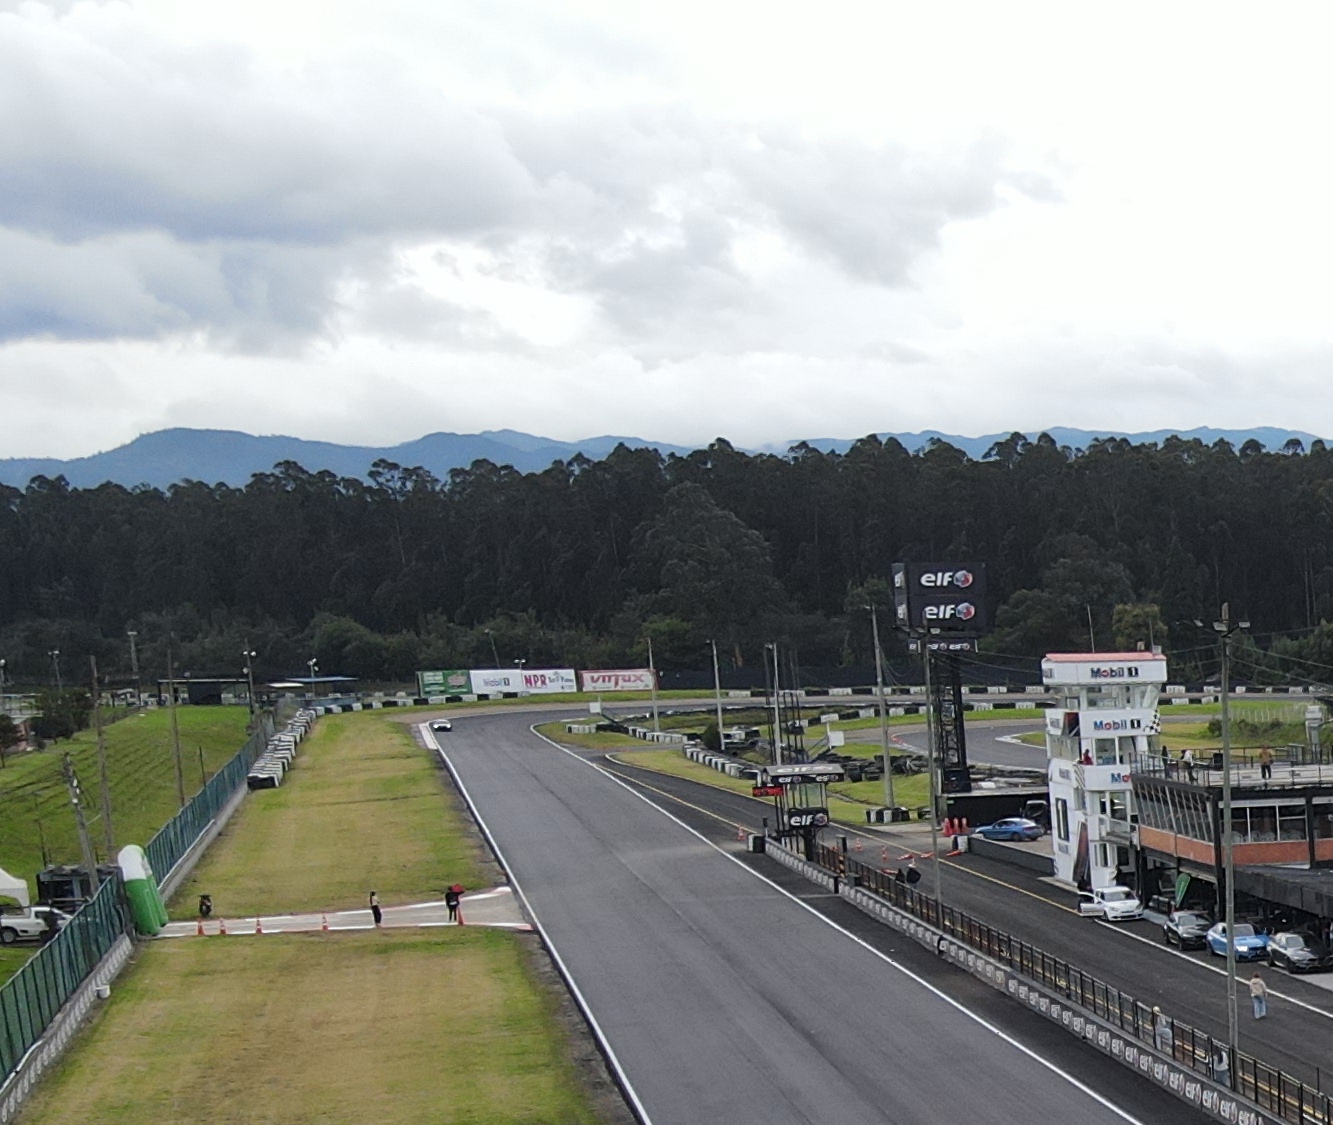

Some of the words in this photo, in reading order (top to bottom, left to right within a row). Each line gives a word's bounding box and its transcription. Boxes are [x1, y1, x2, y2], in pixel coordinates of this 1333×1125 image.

[921, 572, 953, 586] elf
[924, 605, 955, 619] elf
[1091, 667, 1124, 678] Mobil
[1094, 720, 1127, 730] Mobil
[790, 815, 814, 826] elf
